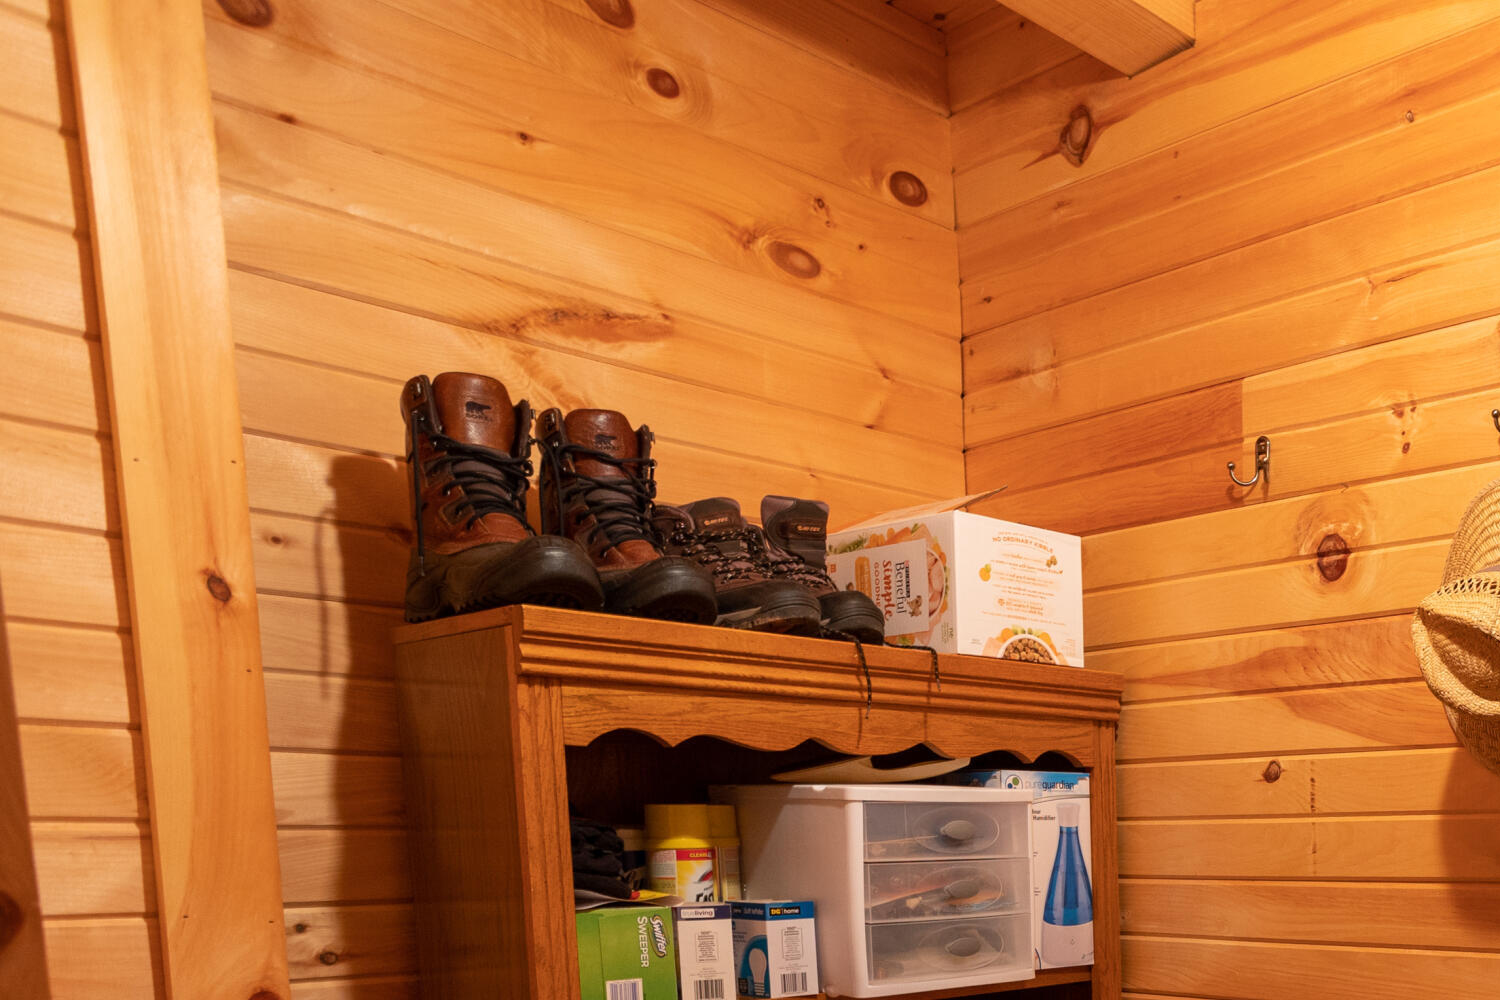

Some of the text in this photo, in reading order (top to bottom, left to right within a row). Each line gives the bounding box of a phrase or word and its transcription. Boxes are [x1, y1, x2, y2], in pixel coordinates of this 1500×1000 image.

[883, 560, 896, 621] Simple
[896, 562, 907, 614] Beneful
[637, 916, 650, 968] SWEEPER
[650, 915, 667, 953] Swiffer
